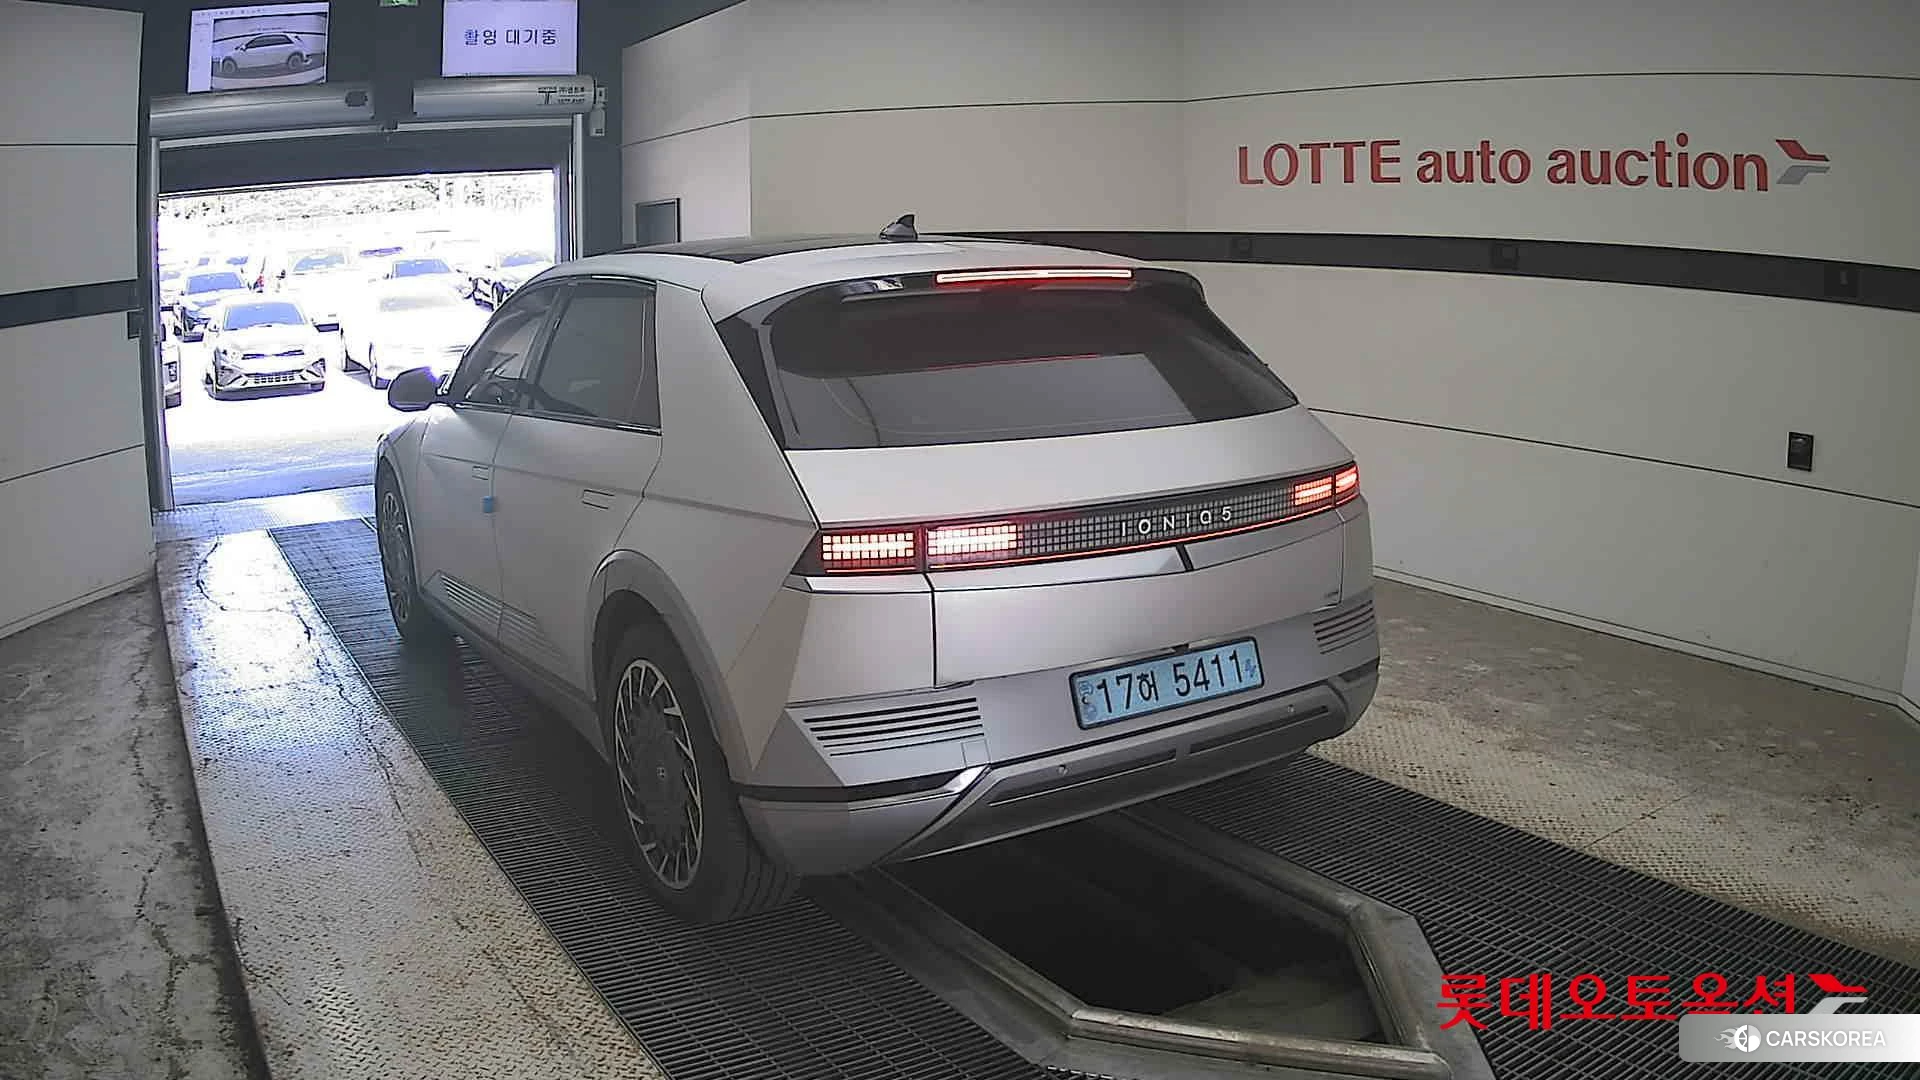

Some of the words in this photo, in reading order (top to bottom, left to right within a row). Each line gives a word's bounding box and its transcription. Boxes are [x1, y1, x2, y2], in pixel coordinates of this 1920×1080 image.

[464, 29, 497, 46] 촬영
[505, 28, 556, 45] 대기중
[1239, 139, 1401, 186] LOTTE
[1416, 139, 1531, 185] auto
[1547, 132, 1768, 191] auction
[1097, 669, 1160, 714] 17허
[1173, 649, 1244, 697] 5411
